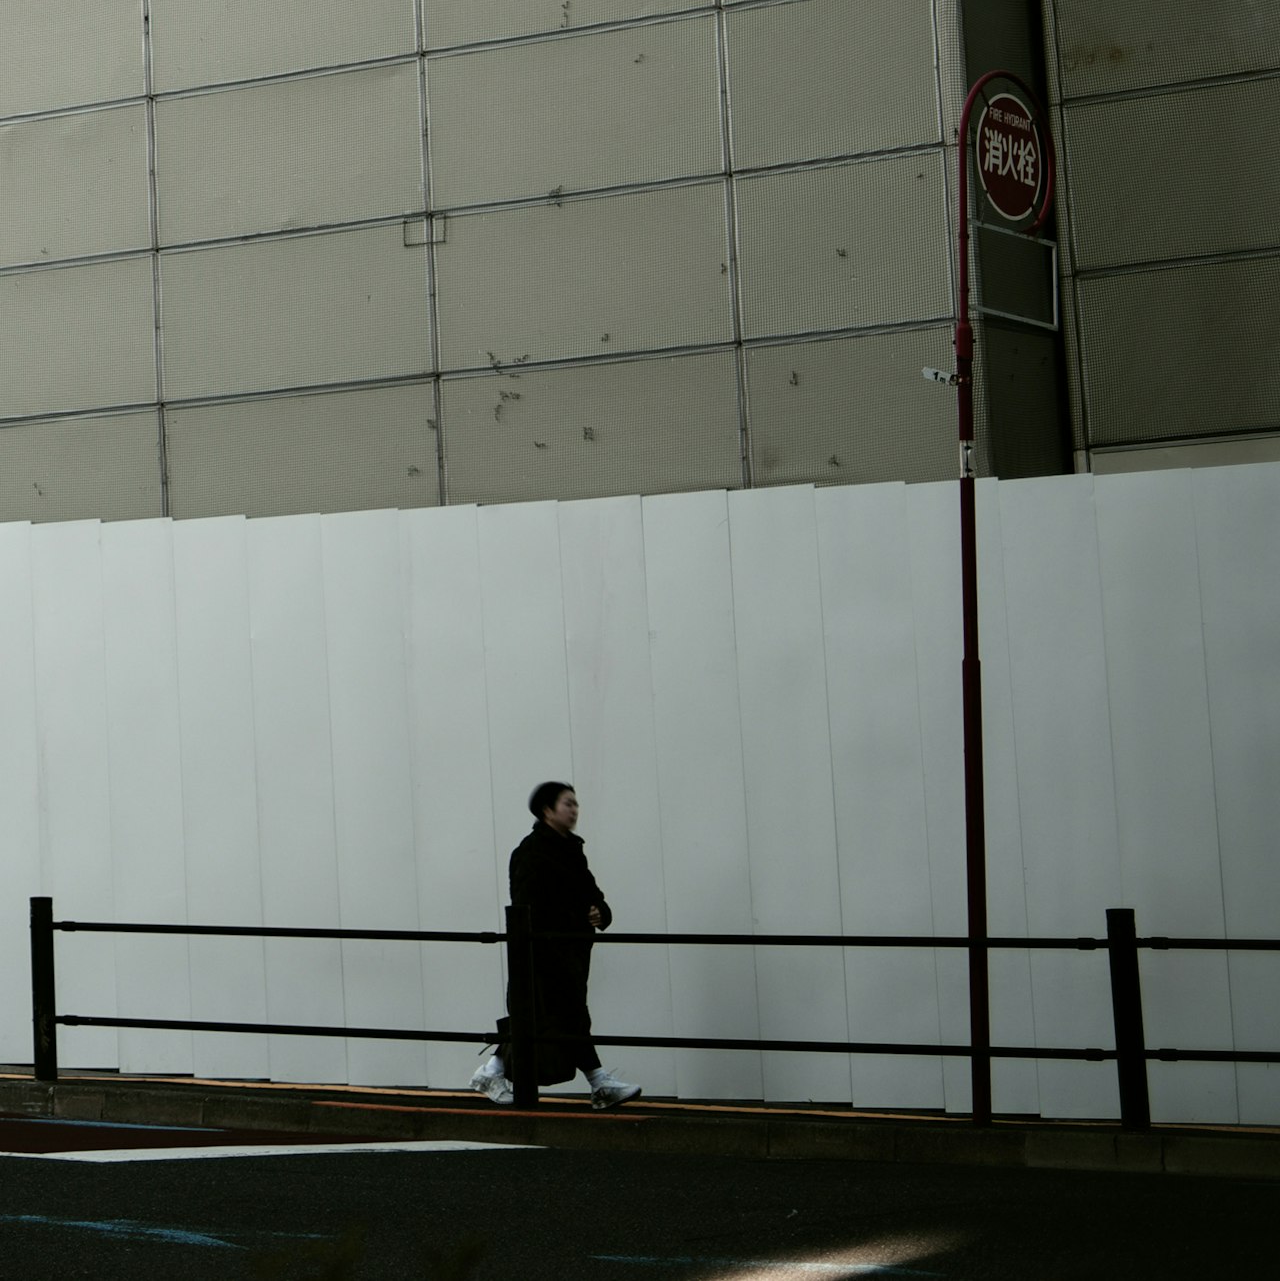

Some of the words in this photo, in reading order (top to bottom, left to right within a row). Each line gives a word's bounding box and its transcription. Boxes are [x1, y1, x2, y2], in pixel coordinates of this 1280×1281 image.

[989, 107, 1003, 122] FIRE
[1004, 112, 1031, 132] HYDRANT
[984, 126, 1036, 186] 消火栓
